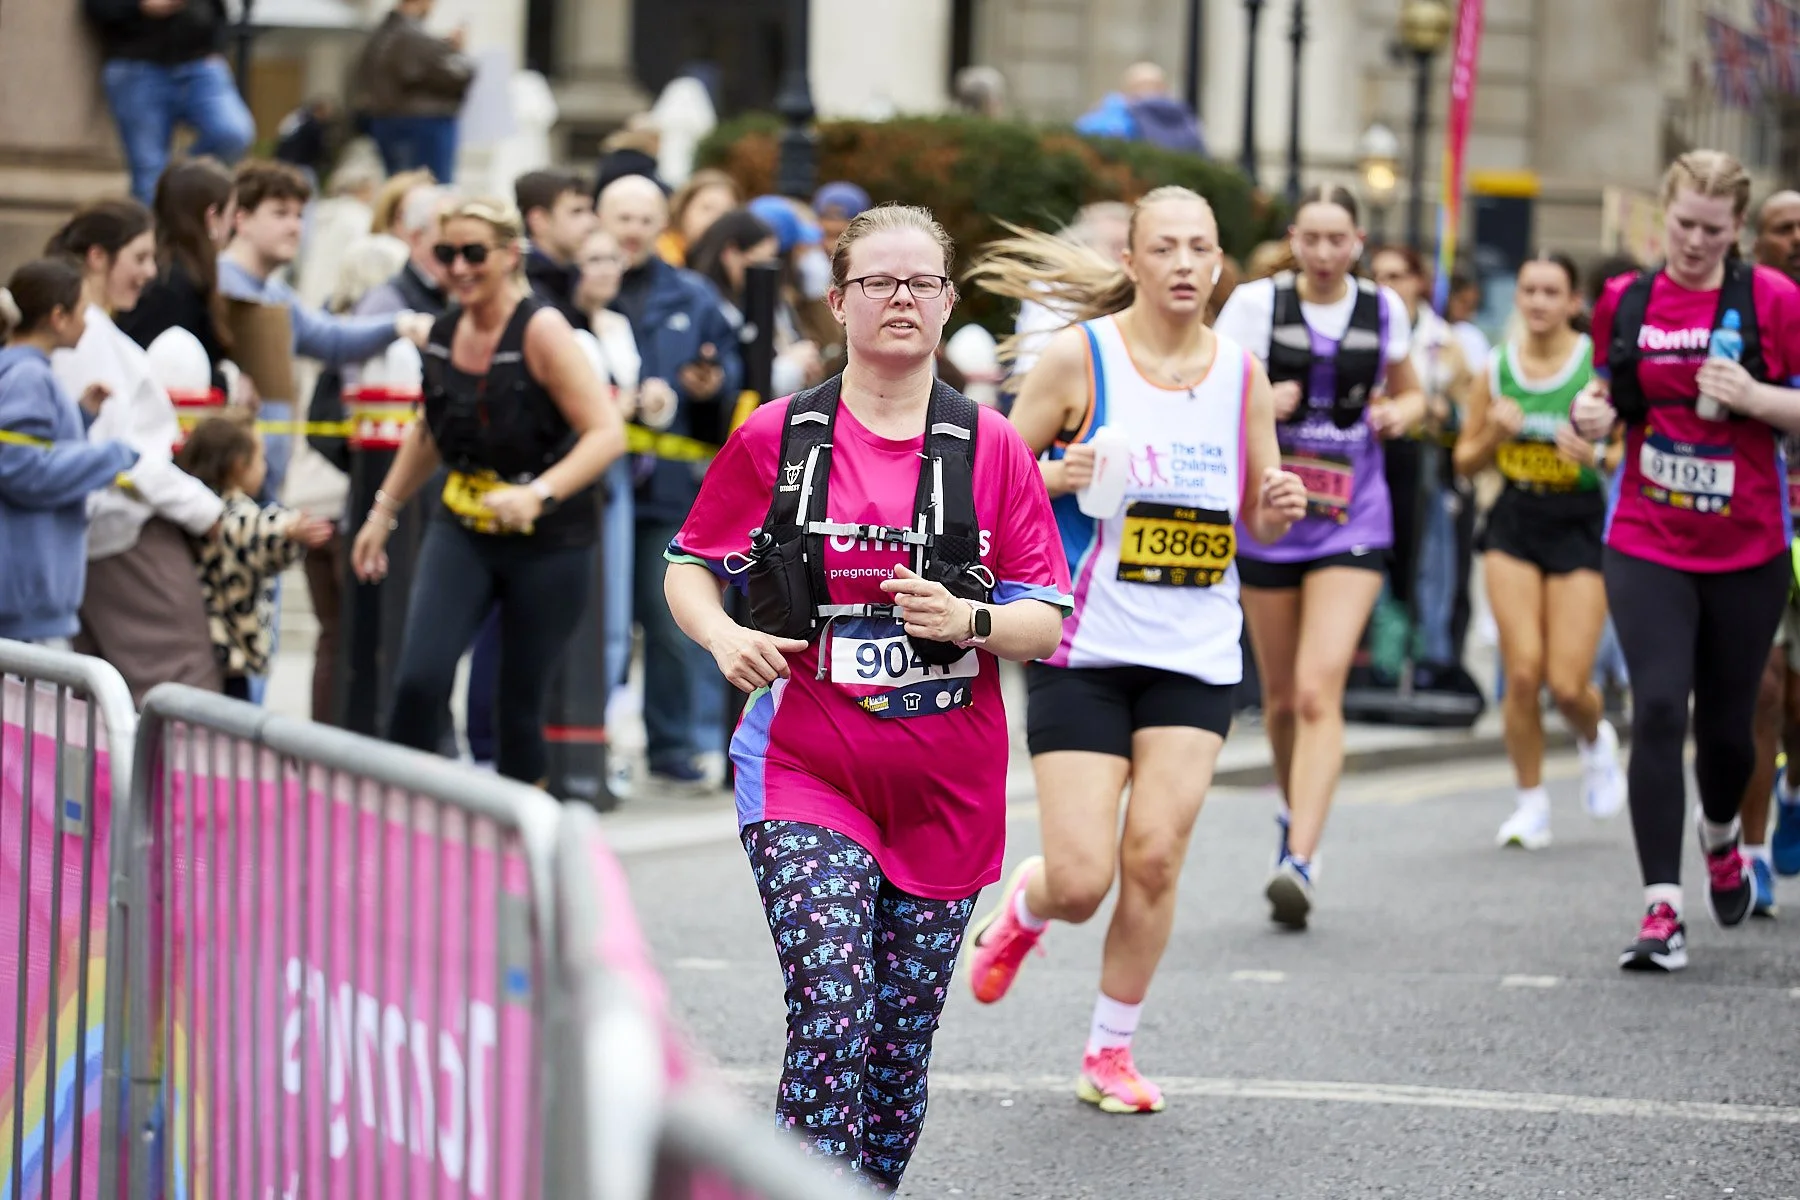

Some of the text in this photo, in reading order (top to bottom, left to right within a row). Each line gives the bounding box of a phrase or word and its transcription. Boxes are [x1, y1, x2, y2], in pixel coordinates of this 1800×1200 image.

[1637, 324, 1709, 350] Tomm
[1652, 454, 1717, 490] 9193
[1132, 527, 1231, 559] 13863
[830, 567, 894, 579] pregnancy
[855, 641, 951, 679] 904
